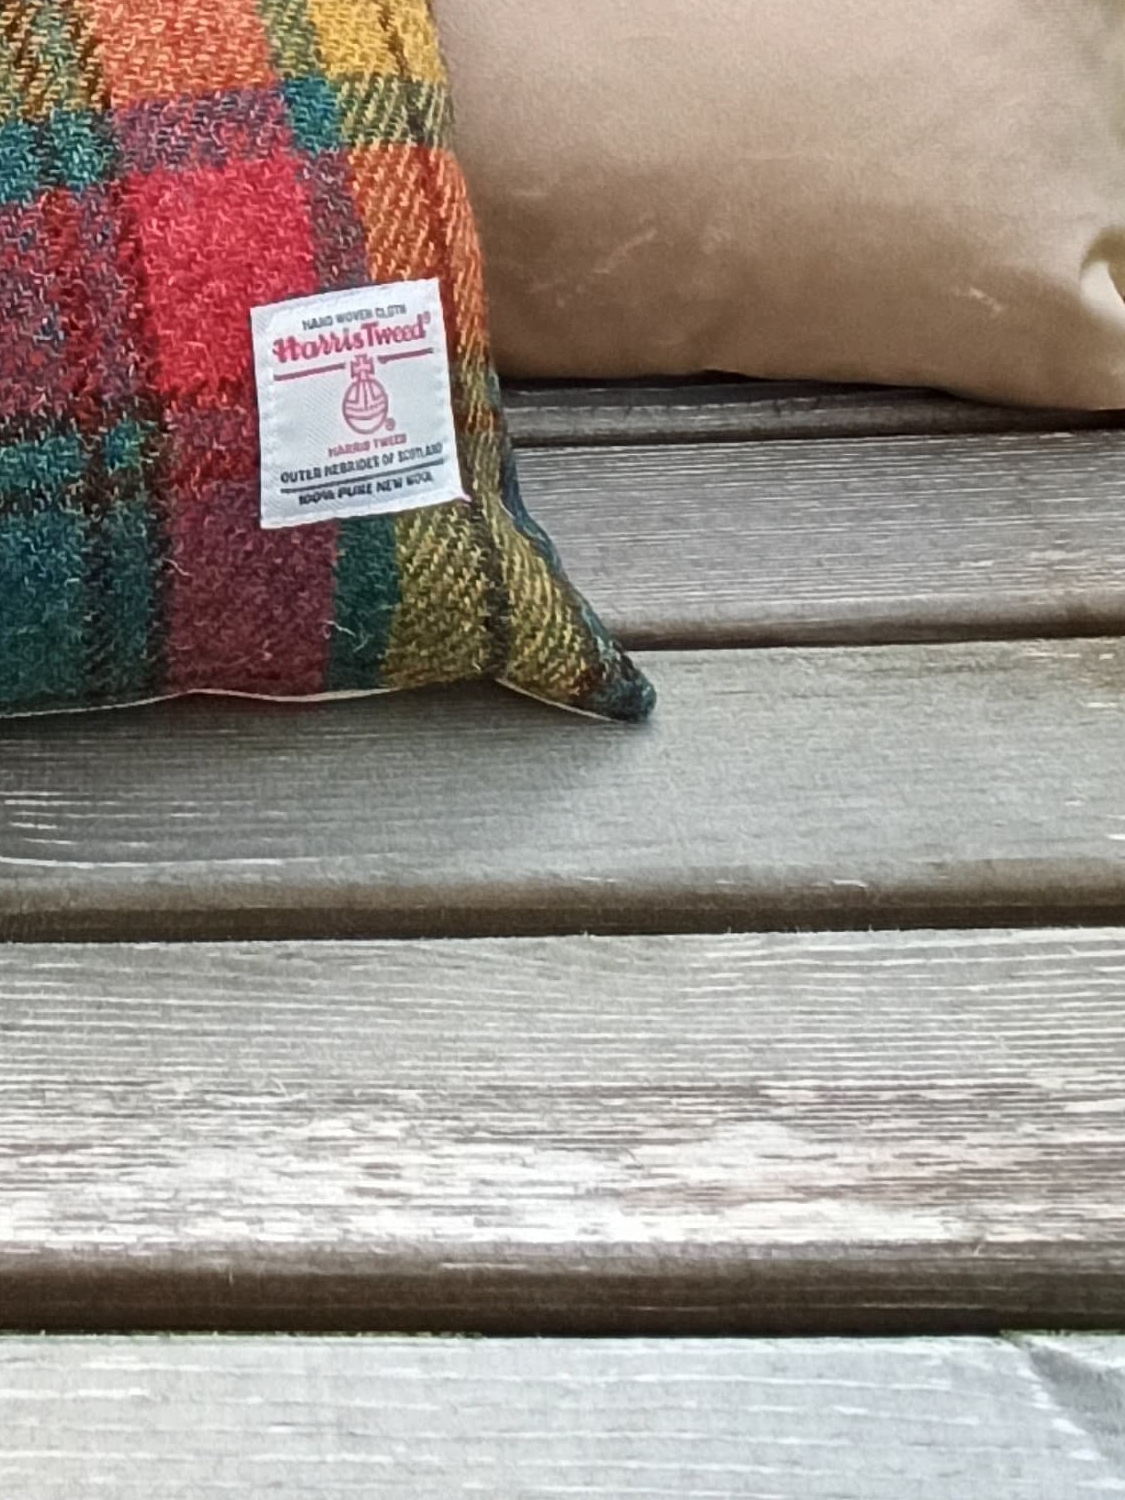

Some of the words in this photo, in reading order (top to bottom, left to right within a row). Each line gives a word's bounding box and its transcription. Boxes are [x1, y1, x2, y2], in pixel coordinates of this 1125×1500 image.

[336, 308, 373, 323] WOVEN
[376, 304, 406, 318] CLOTH
[273, 327, 363, 363] Harris
[281, 467, 322, 483] OUTER
[324, 457, 380, 476] HEBRIDES
[382, 453, 395, 467] OF
[398, 443, 442, 462] SCOTLAND
[338, 482, 372, 498] PURE
[376, 478, 403, 493] NEW
